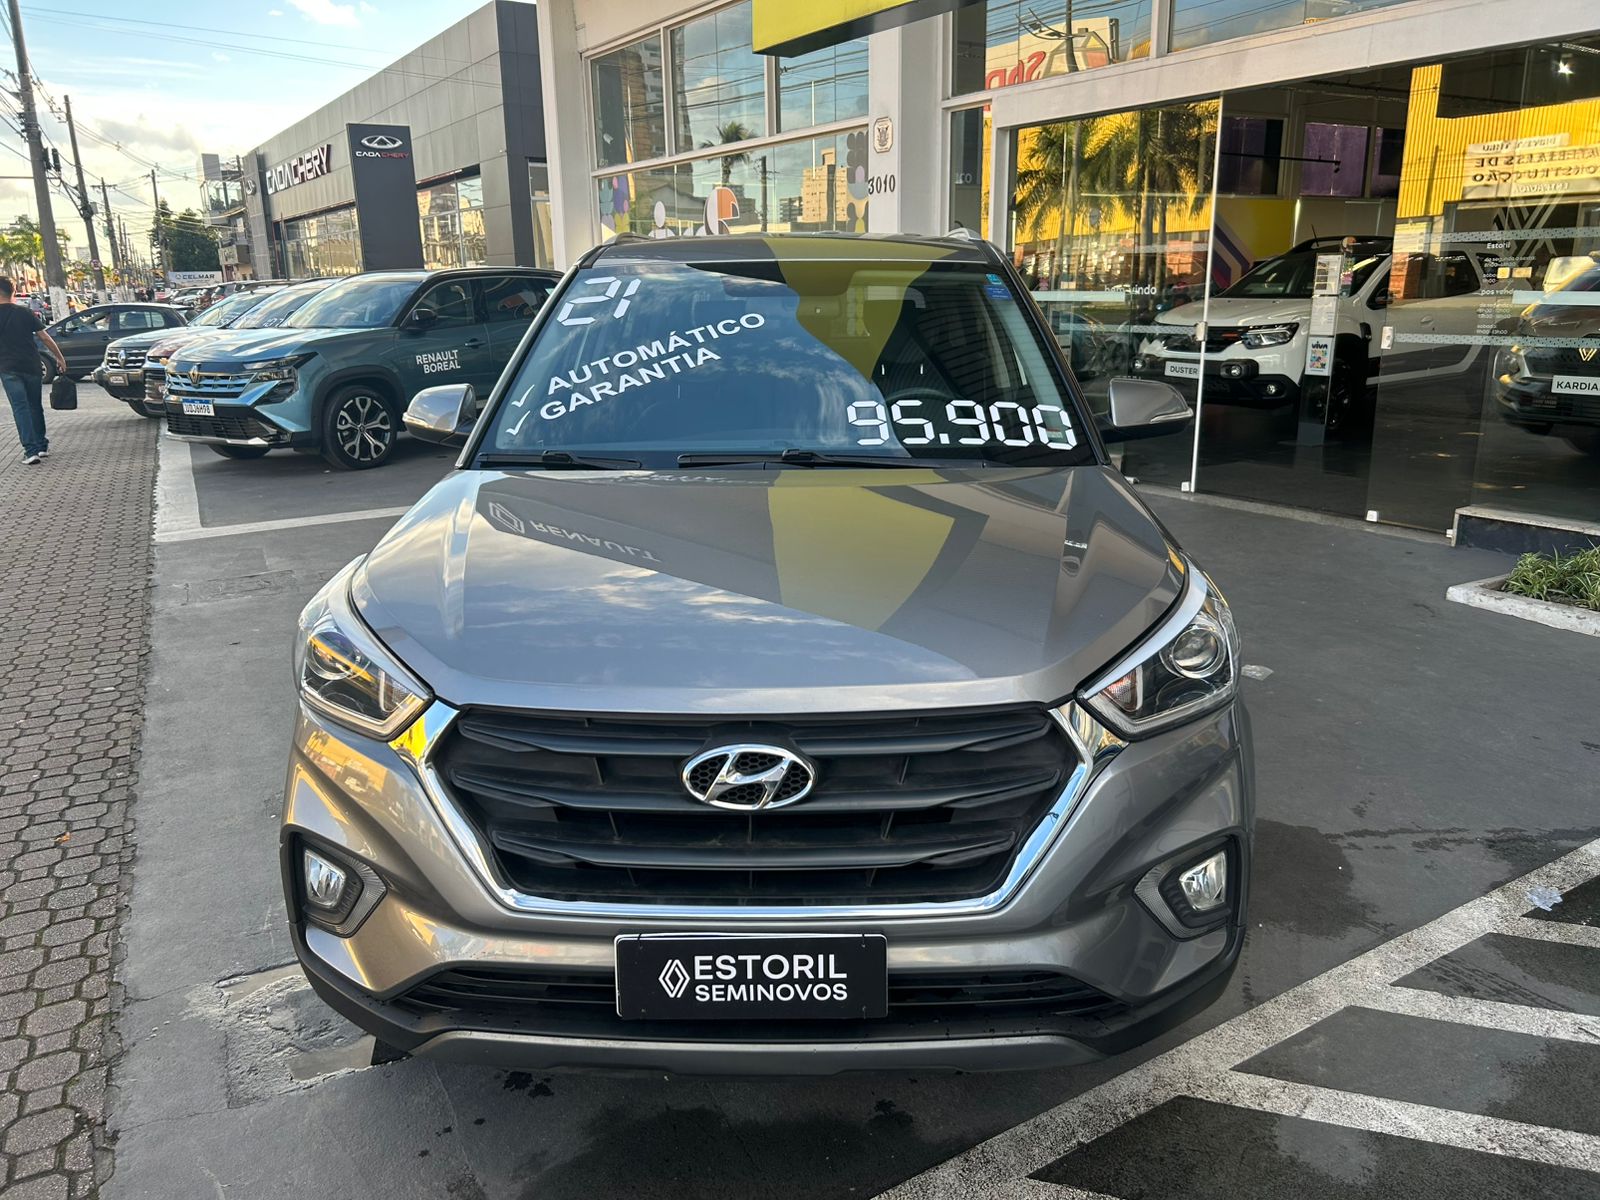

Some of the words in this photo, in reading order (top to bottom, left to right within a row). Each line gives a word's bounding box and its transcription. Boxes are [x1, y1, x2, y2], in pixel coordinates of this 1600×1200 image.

[290, 144, 329, 185] CHERY
[868, 174, 896, 195] 3010
[556, 276, 642, 326] 21
[415, 350, 458, 365] RENAULT
[548, 313, 765, 395] AUTOMÁTICO
[423, 360, 461, 374] BOREAL
[1169, 365, 1199, 375] DUSTER
[540, 347, 721, 420] GARANTIA
[1556, 381, 1600, 392] KARDIA
[846, 399, 1078, 450] 95.900
[693, 953, 848, 980] ESTORIL
[694, 983, 848, 1002] SEMINOVOS
